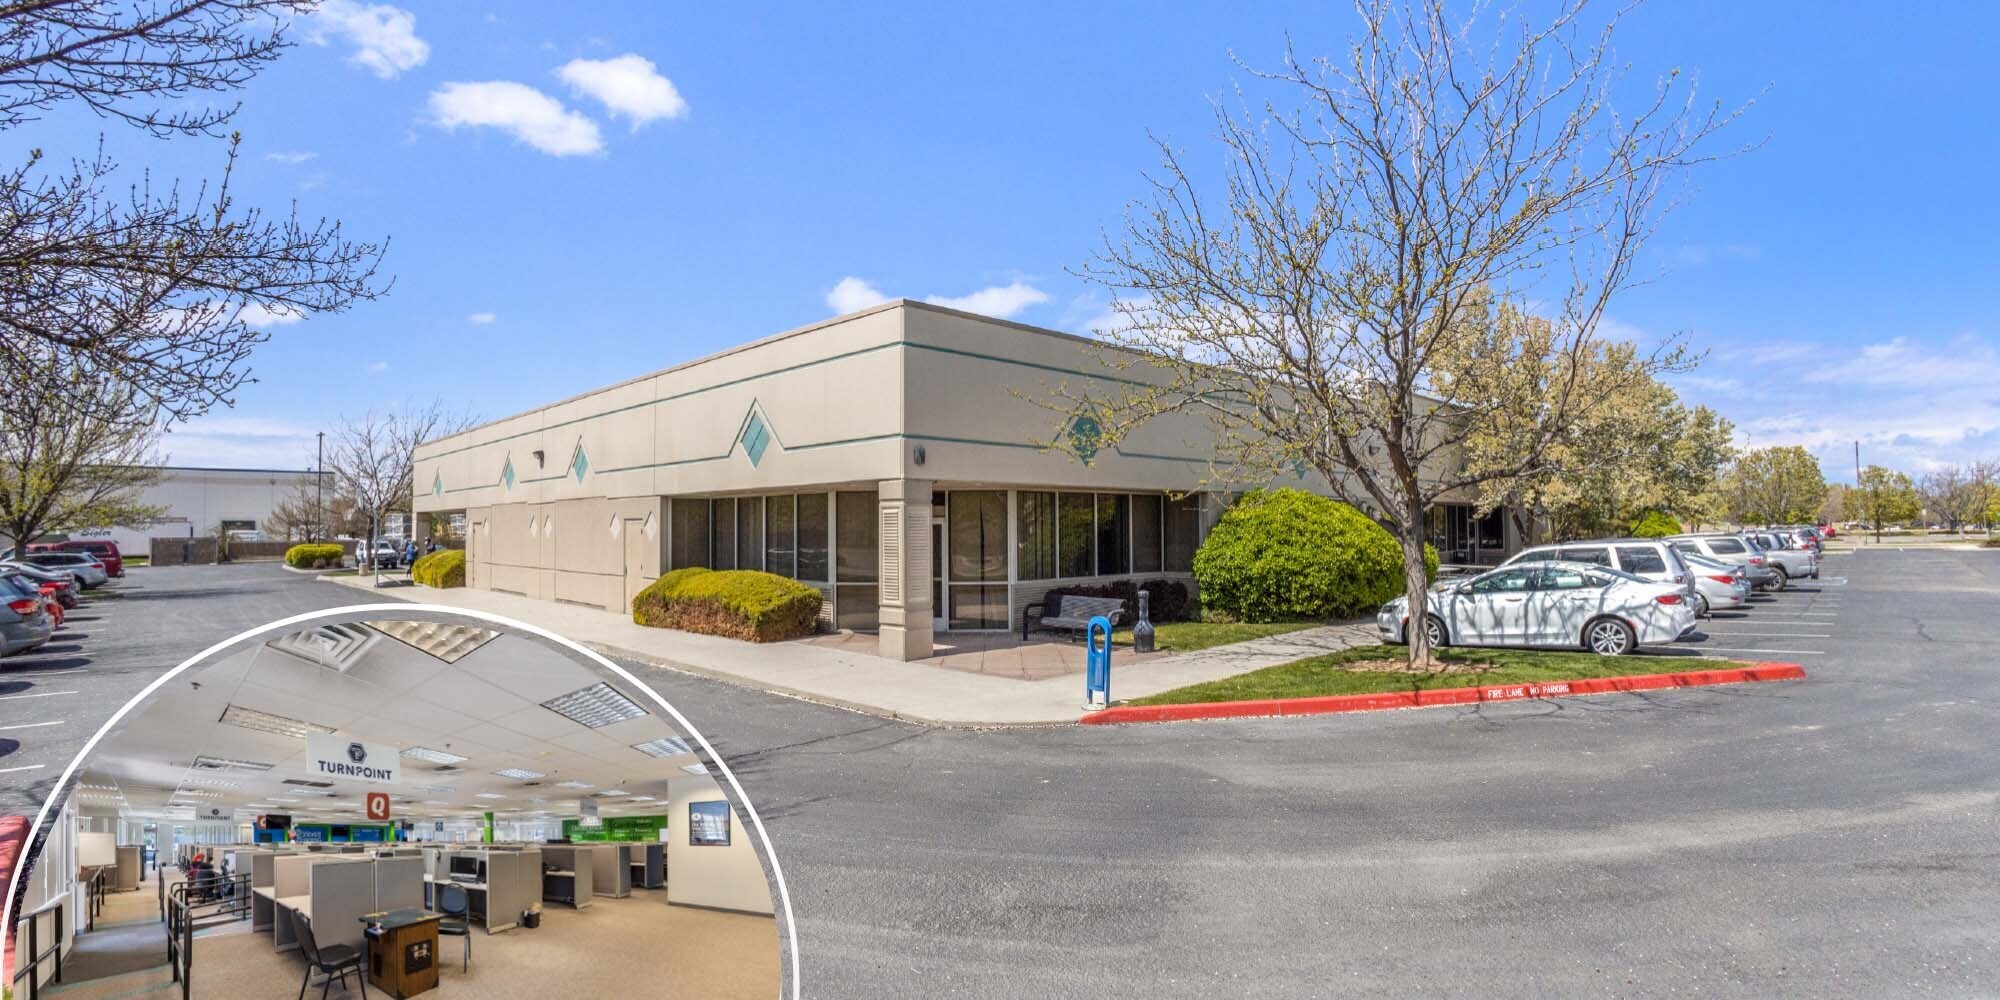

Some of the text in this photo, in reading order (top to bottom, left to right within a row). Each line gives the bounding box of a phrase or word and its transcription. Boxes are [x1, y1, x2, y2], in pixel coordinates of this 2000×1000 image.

[1488, 684, 1569, 698] FIRE LANE NO PARKING
[318, 760, 392, 780] TURNPOINT
[371, 796, 385, 817] Q
